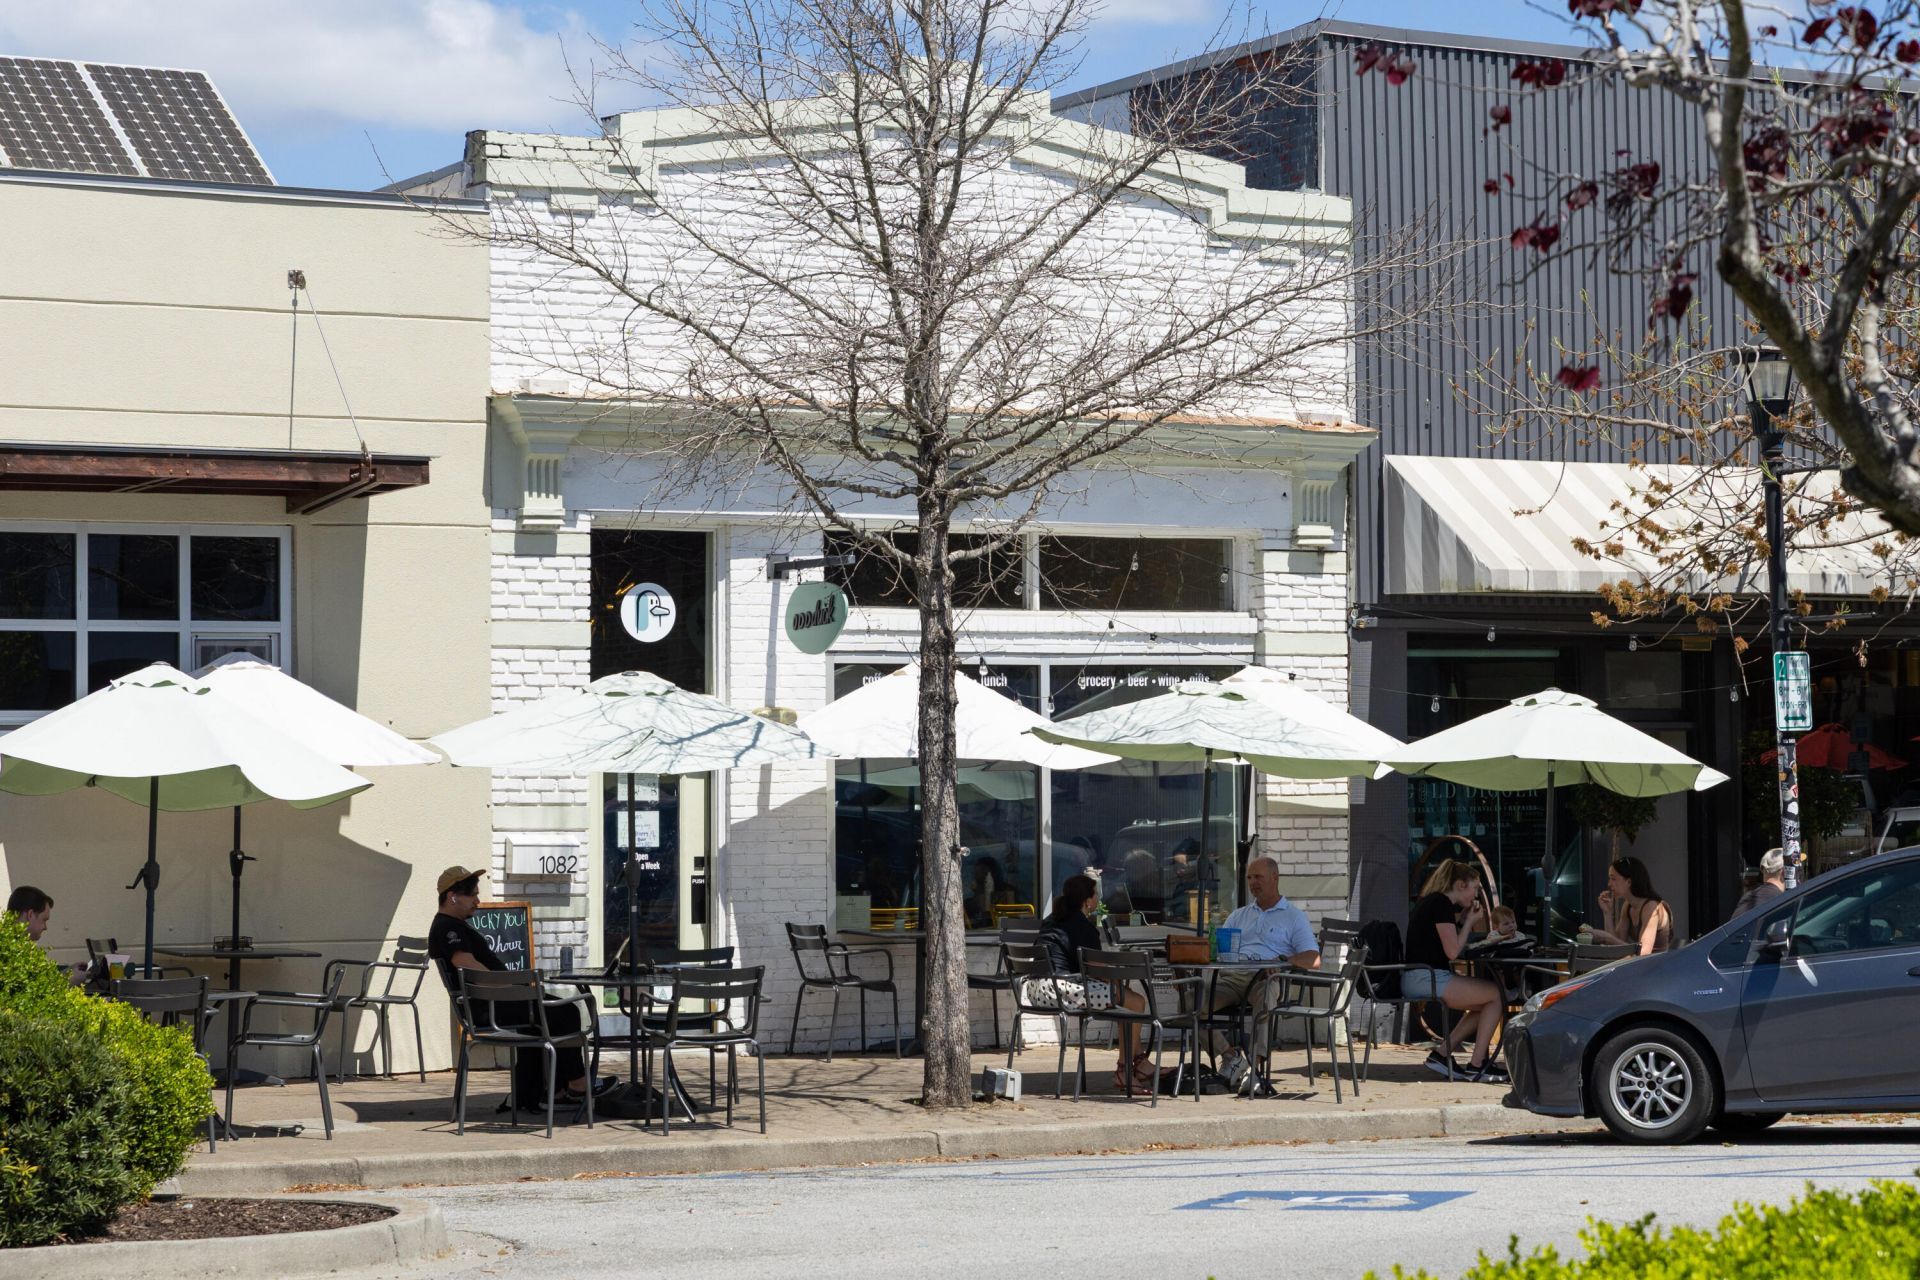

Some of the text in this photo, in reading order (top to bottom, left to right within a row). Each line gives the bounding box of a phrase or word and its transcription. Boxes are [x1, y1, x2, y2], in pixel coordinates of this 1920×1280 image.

[1778, 659, 1786, 678] 2
[1079, 674, 1116, 690] grocery
[1128, 672, 1149, 687] beer
[1158, 672, 1180, 687] wine
[539, 855, 578, 874] 1082
[472, 909, 526, 930] UCKY YOU!
